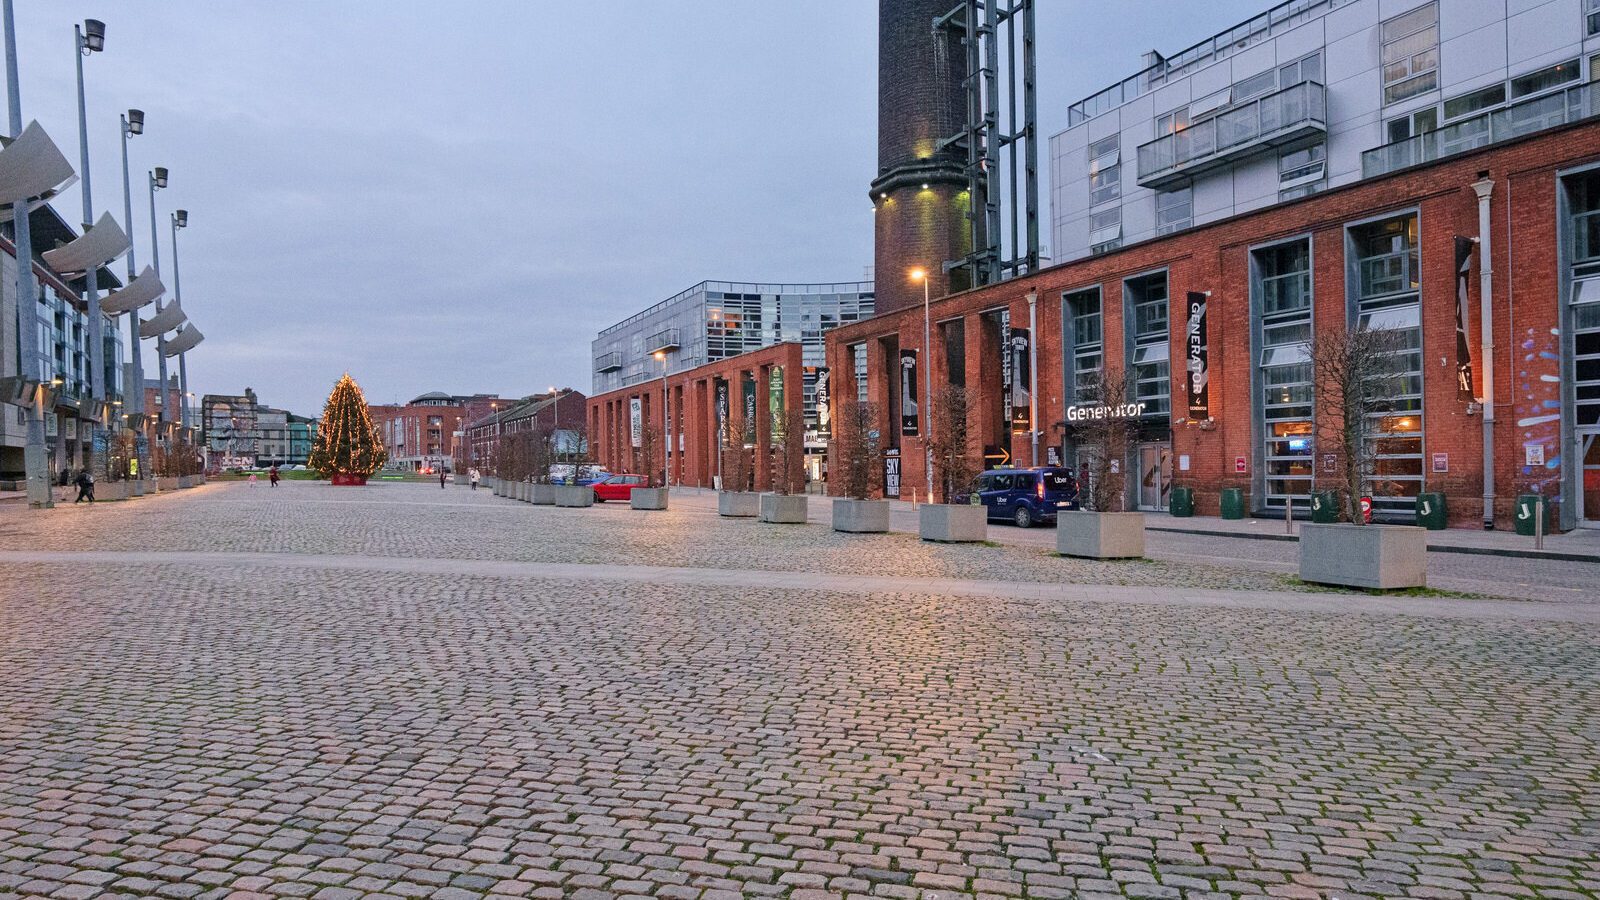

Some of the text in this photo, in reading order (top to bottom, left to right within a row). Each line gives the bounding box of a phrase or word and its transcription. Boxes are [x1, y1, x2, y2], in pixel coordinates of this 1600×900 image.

[1191, 302, 1203, 395] GENERATOR
[719, 393, 727, 437] SPARKS
[886, 458, 899, 474] SKY
[1054, 476, 1067, 484] Uber
[1420, 501, 1432, 516] J
[1518, 503, 1531, 520] J
